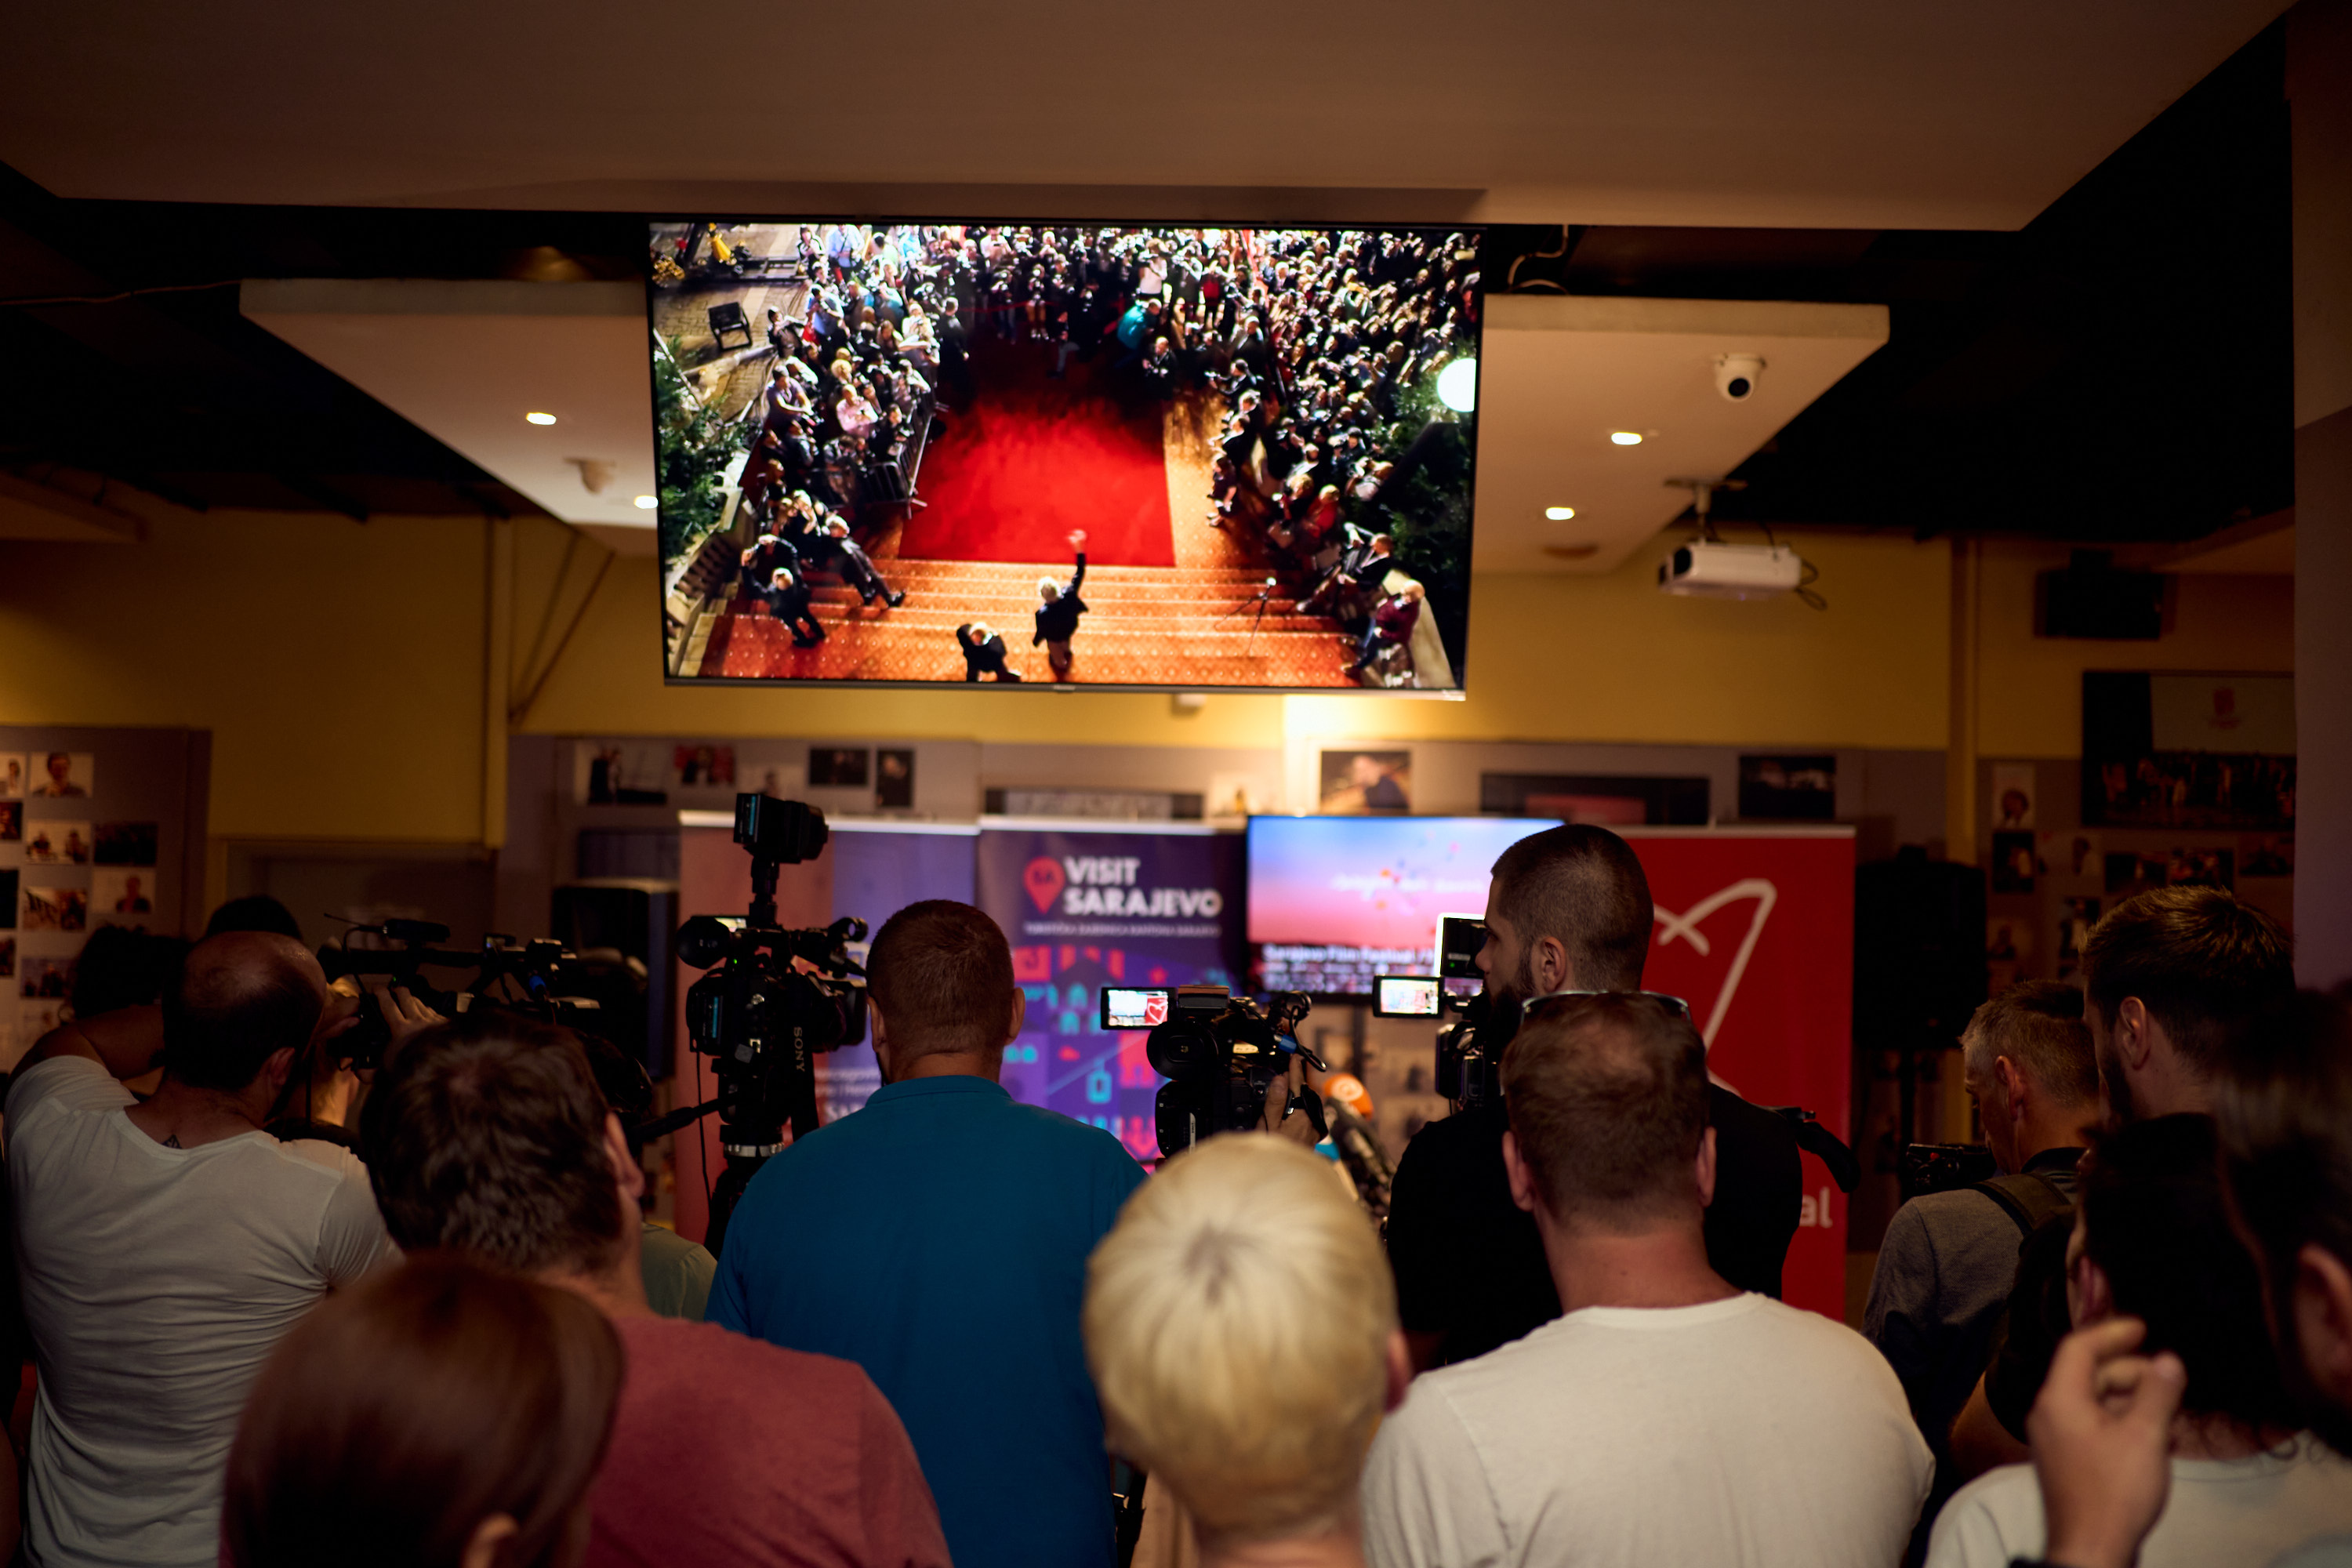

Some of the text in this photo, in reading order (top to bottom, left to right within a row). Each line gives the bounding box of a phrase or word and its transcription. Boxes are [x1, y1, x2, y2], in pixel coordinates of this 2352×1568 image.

[1064, 856, 1140, 885] VISIT
[1063, 888, 1223, 916] SARAJEVO
[793, 1026, 806, 1073] SONY
